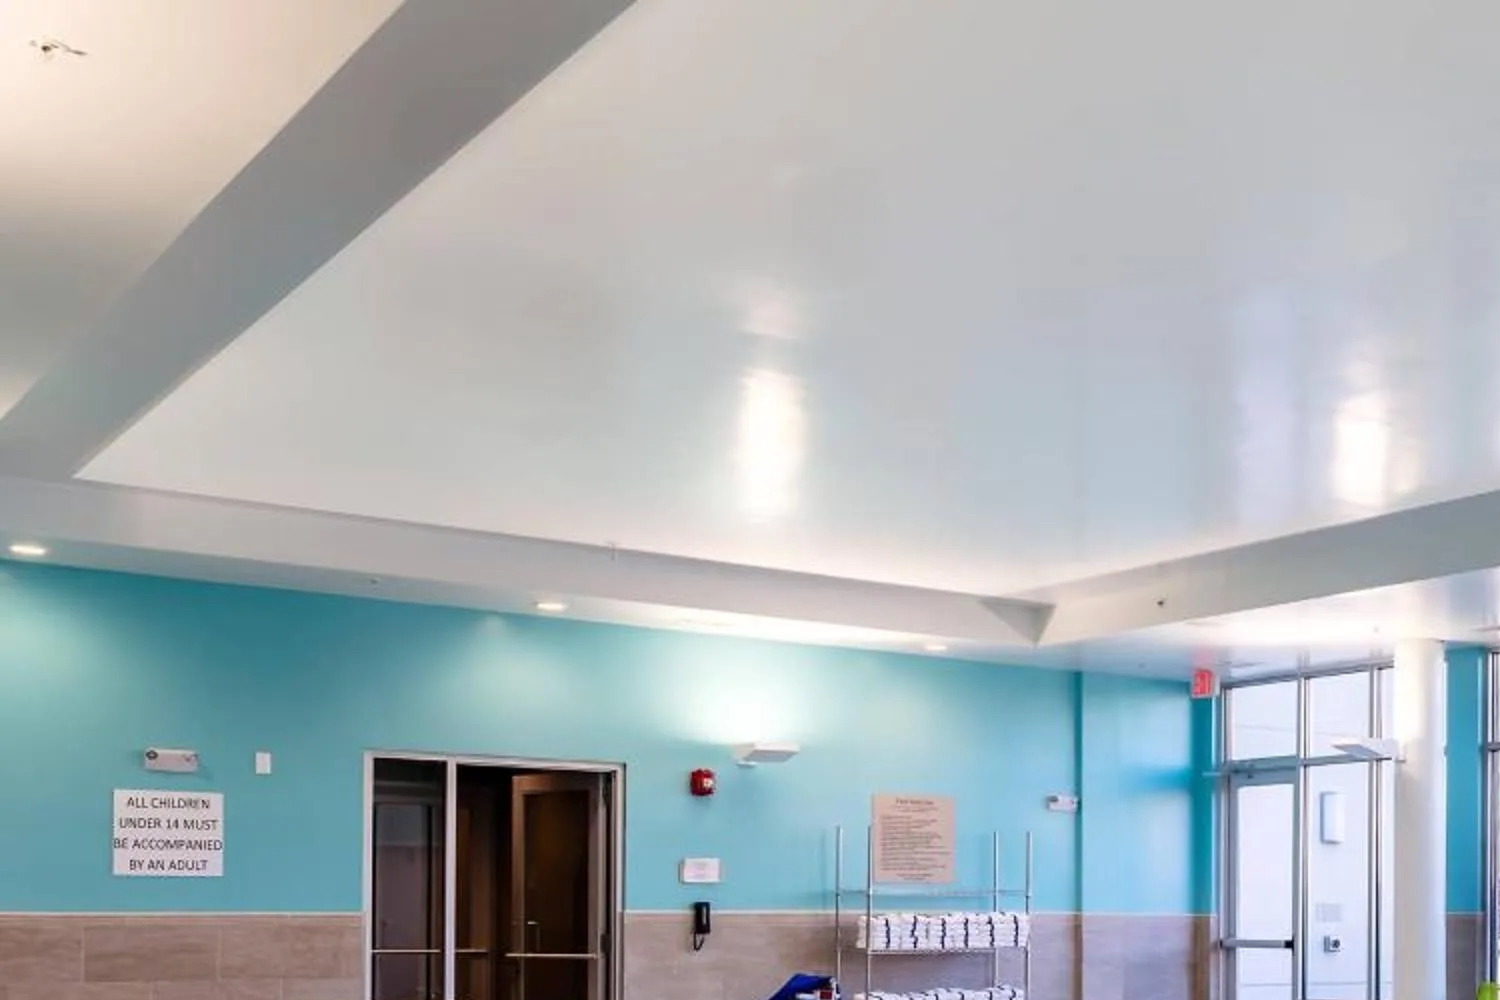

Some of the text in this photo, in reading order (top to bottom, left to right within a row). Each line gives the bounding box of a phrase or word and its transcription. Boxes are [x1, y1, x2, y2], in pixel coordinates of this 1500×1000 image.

[126, 797, 211, 810] ALL CHILDREN
[119, 817, 219, 831] UNDER 14 MUST
[114, 837, 224, 851] BE ACCOMPANIED
[129, 859, 208, 871] BY AN ADULT
